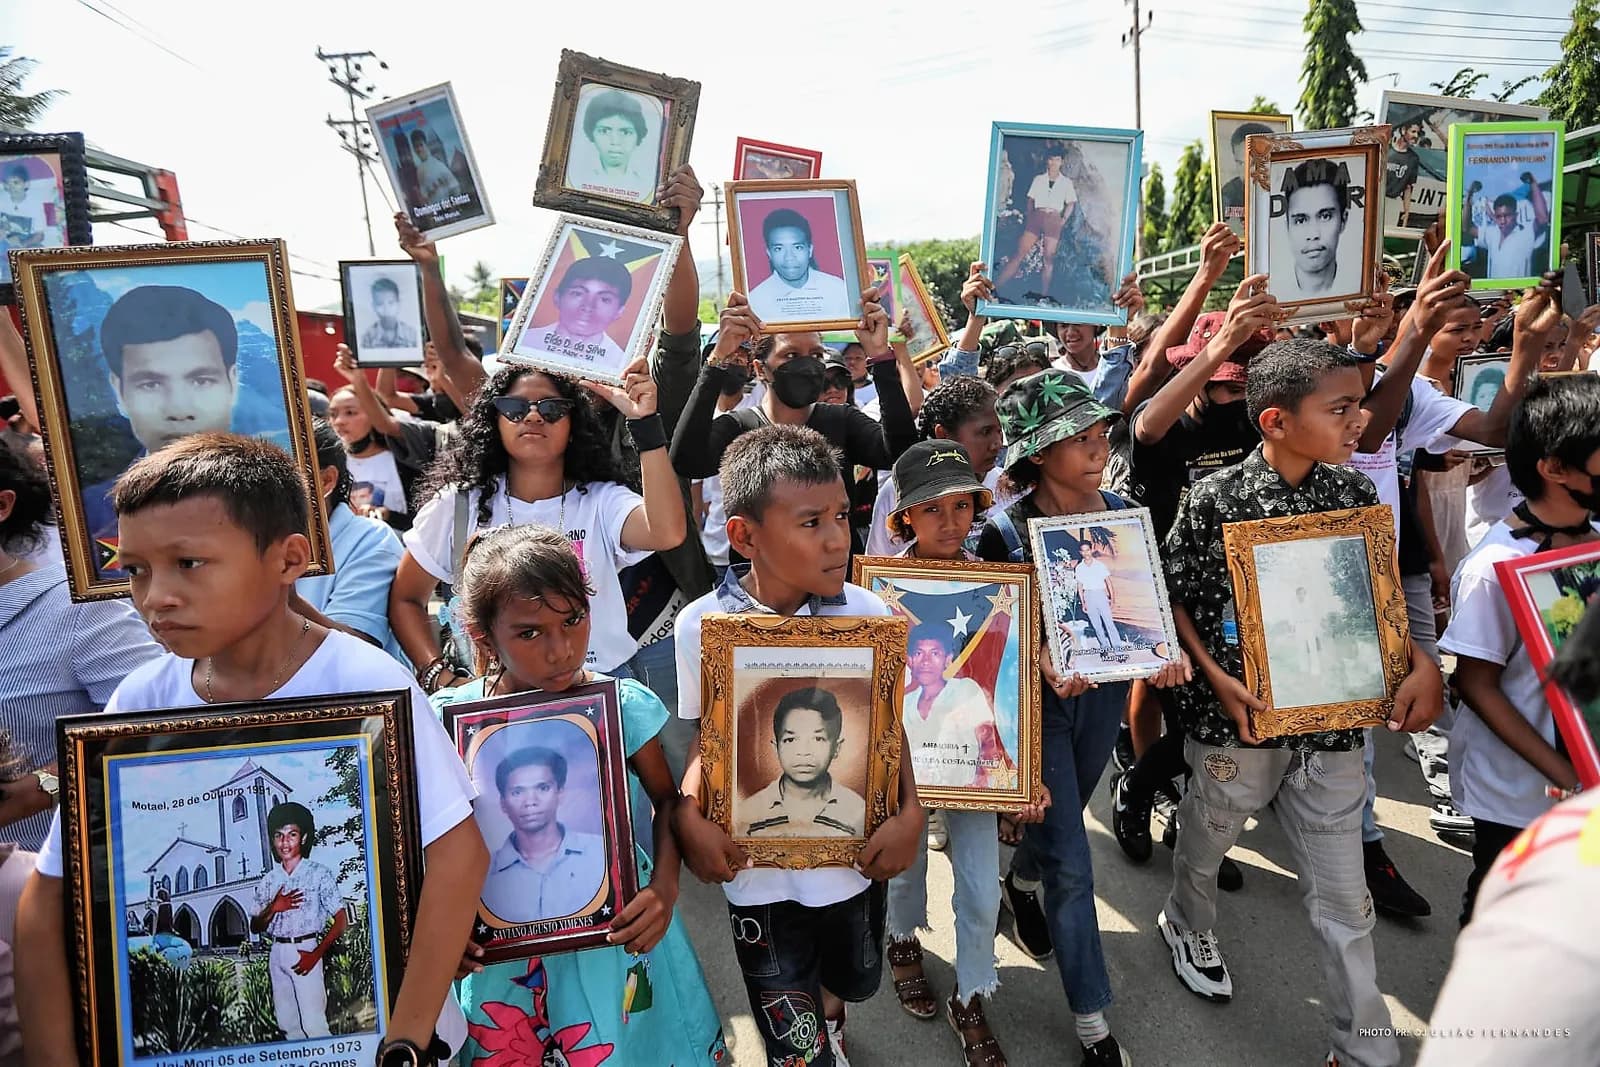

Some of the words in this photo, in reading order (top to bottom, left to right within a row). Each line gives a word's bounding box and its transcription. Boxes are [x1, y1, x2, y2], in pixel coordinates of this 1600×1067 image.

[1468, 156, 1509, 164] FERNANDO
[450, 193, 471, 206] Santos
[586, 344, 606, 357] Silva
[566, 529, 586, 541] RNO
[132, 801, 169, 811] Motael,
[172, 799, 185, 809] 28
[187, 796, 200, 806] de
[202, 788, 244, 801] Outubro
[247, 785, 271, 796] 1991
[493, 927, 527, 940] SAVIANO
[527, 923, 558, 936] AGUSTO
[559, 915, 594, 931] XIMENES
[218, 1054, 235, 1067] 05
[238, 1053, 255, 1065] de
[260, 1047, 325, 1062] Setembro
[329, 1041, 362, 1054] 1973
